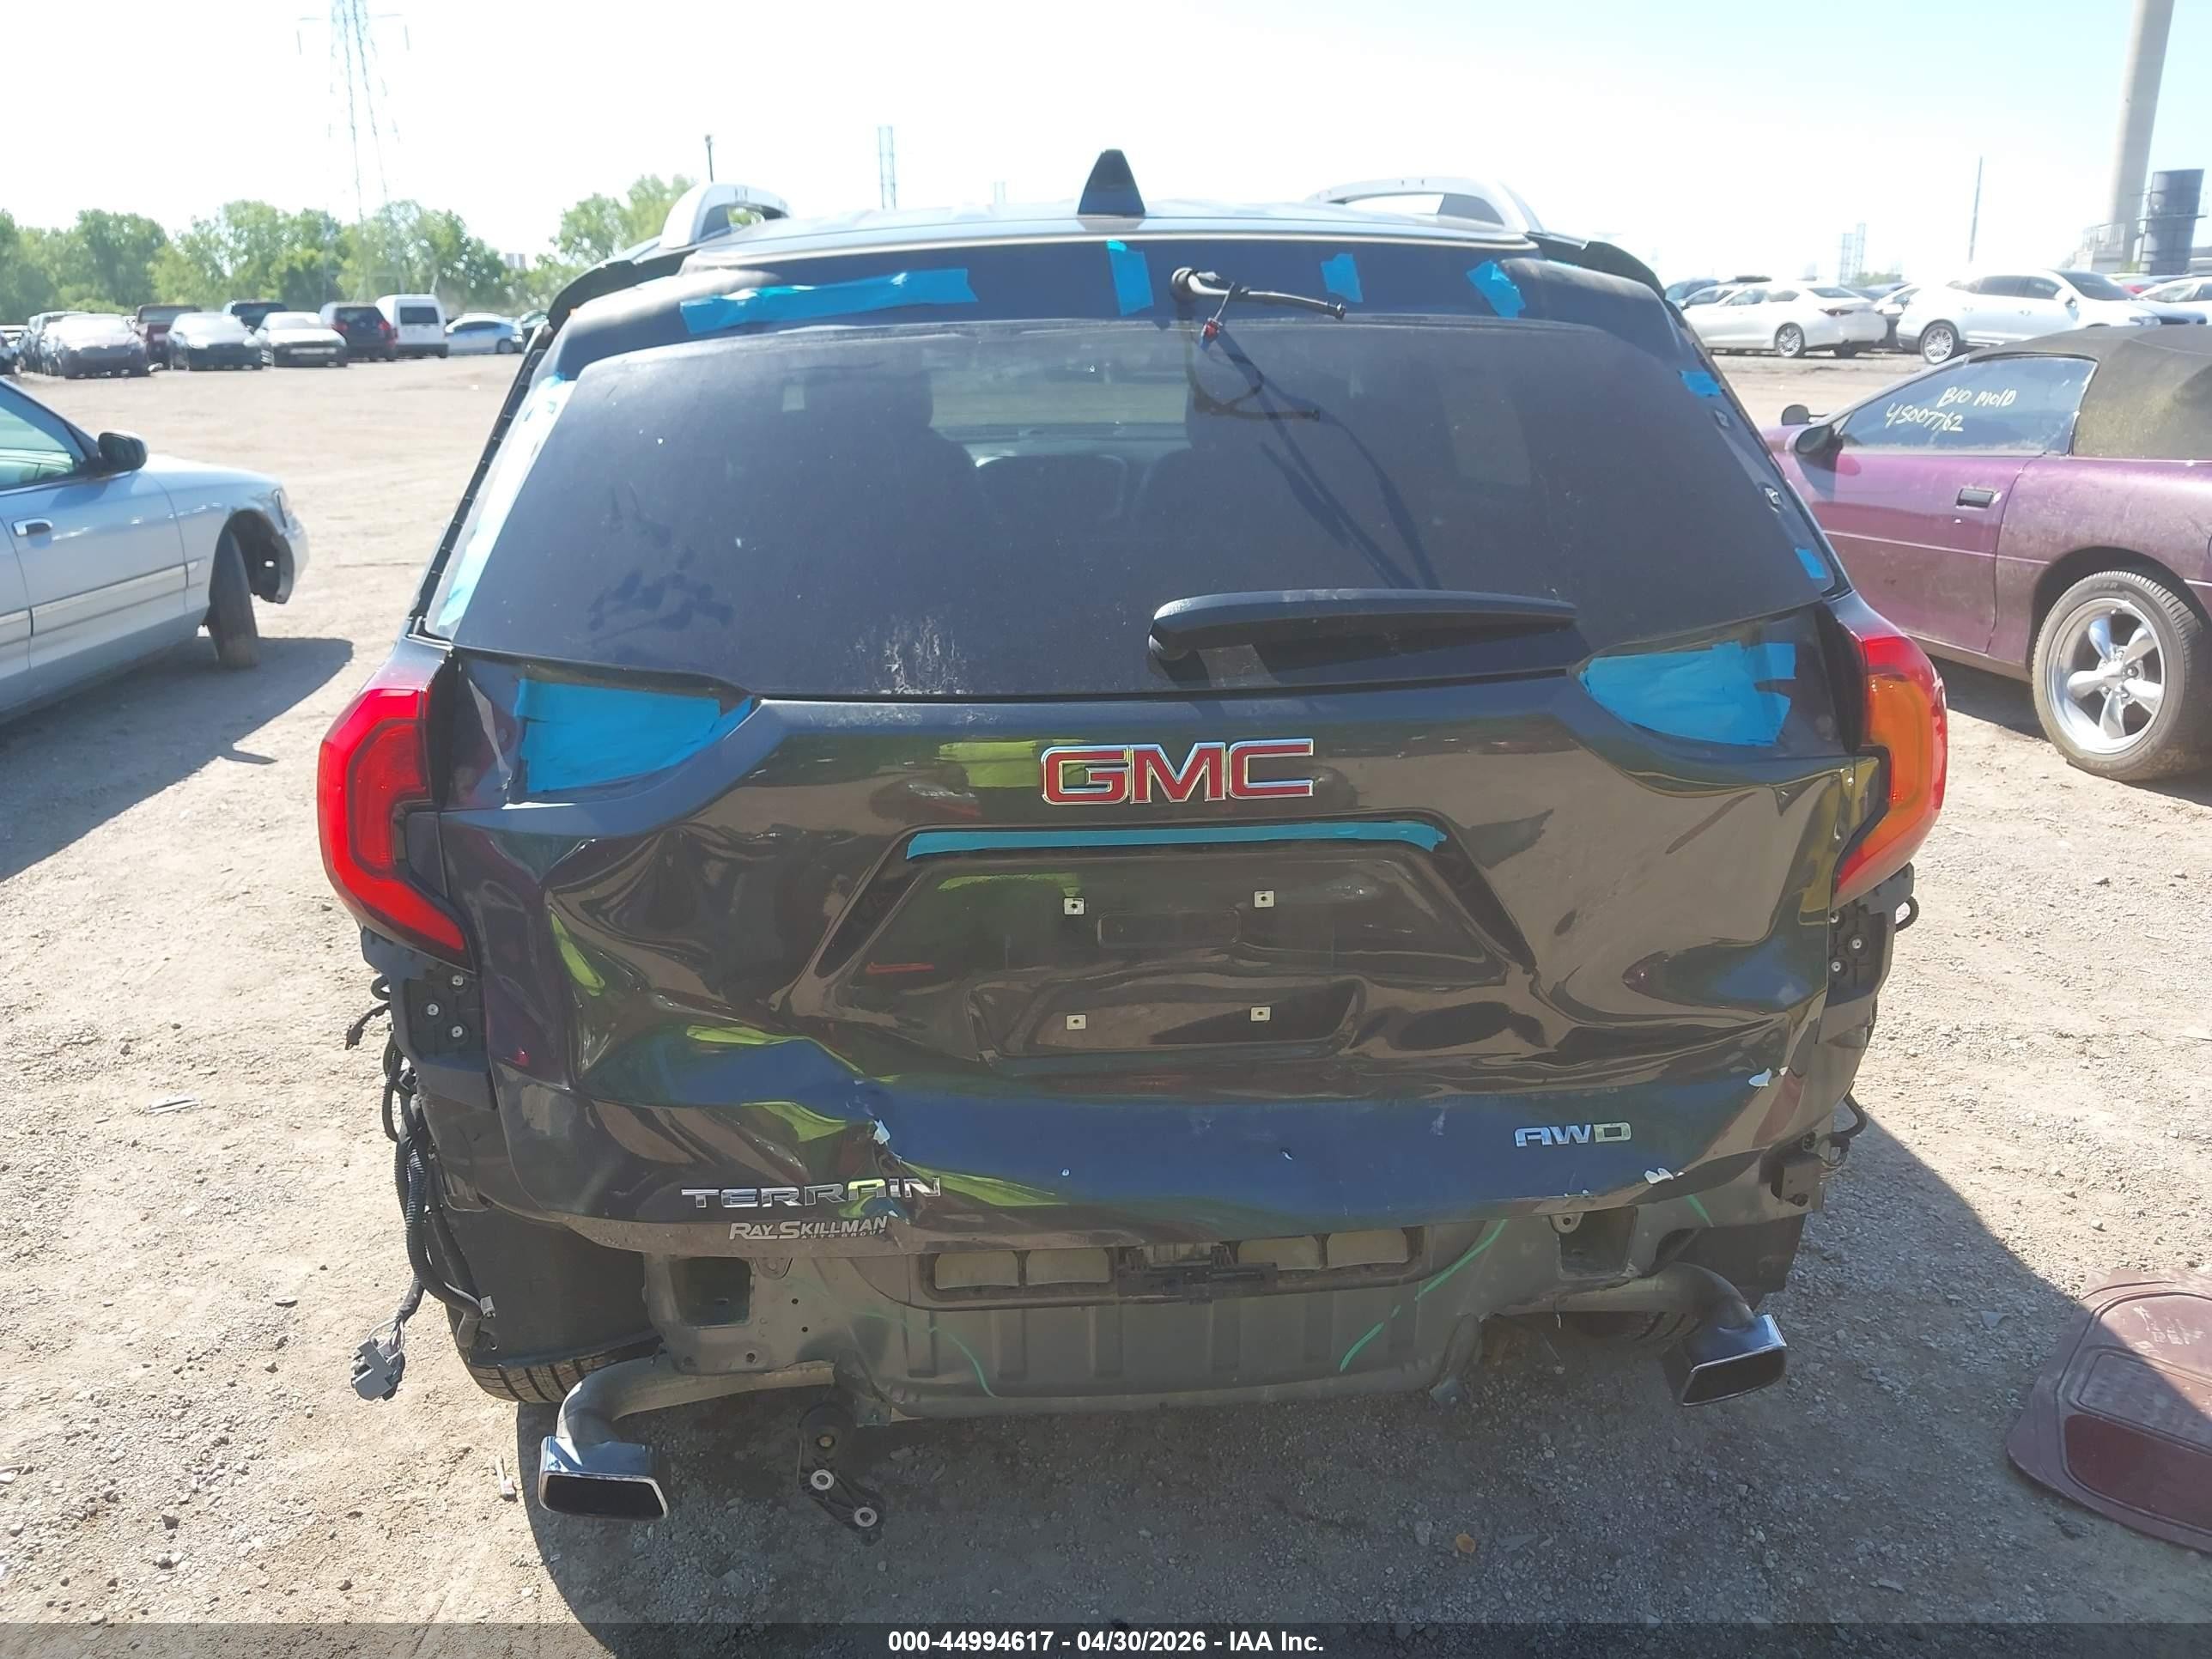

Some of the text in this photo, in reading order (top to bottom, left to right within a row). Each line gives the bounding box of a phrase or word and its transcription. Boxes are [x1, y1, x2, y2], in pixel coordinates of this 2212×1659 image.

[1885, 402, 1964, 432] 45007762
[1040, 738, 1314, 805] GMC
[1514, 1121, 1632, 1147] AWD
[681, 1176, 942, 1209] TERRAIN
[841, 1229, 885, 1238] GROUP
